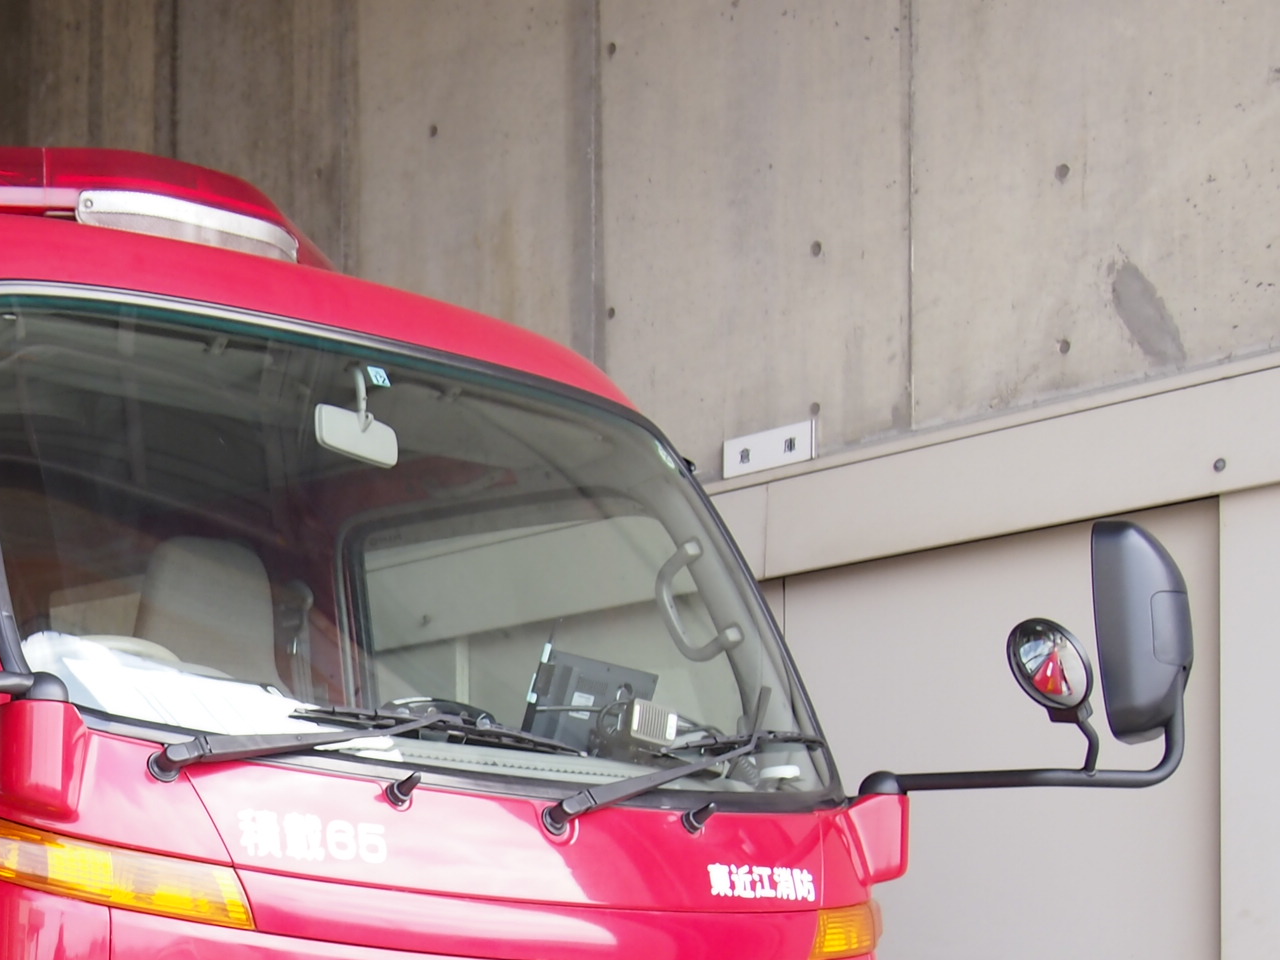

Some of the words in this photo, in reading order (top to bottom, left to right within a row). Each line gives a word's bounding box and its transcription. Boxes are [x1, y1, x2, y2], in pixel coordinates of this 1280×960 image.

[237, 808, 388, 864] 積載65
[707, 862, 815, 901] 東近江消防
